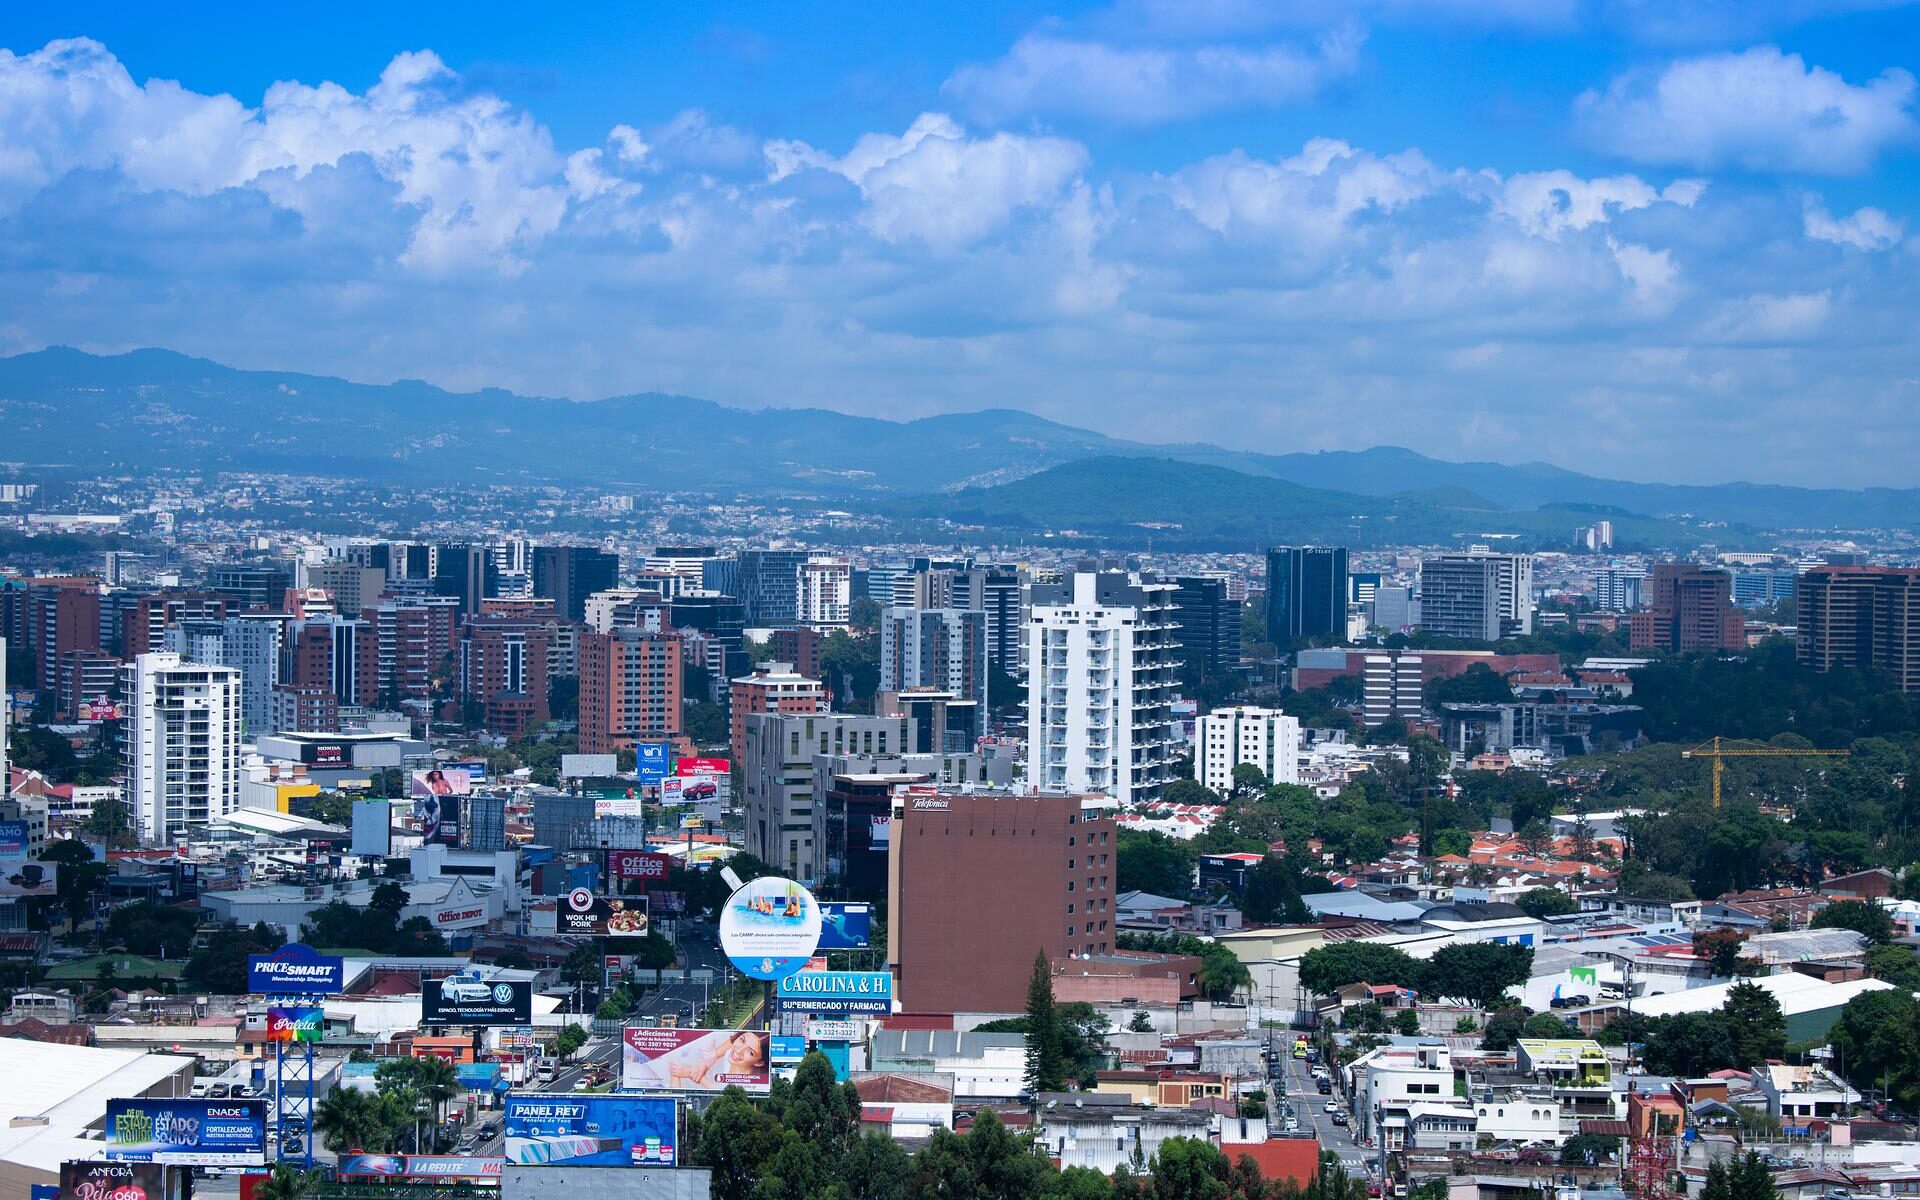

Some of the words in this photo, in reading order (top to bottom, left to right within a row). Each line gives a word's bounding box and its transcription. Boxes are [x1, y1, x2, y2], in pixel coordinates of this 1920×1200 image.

[621, 856, 664, 868] Office
[622, 867, 662, 876] DEPOT
[437, 911, 461, 922] Office
[461, 908, 483, 920] DEPOT
[570, 920, 592, 928] PORK
[782, 975, 856, 993] CAROLINA
[858, 977, 870, 993] &
[873, 977, 887, 993] H.
[843, 1002, 849, 1010] Y
[849, 1002, 886, 1011] FARMACIA
[273, 1019, 317, 1030] Paleta
[126, 1108, 135, 1118] DE
[163, 1110, 173, 1118] UN
[516, 1105, 553, 1116] PANEL
[555, 1106, 580, 1117] REY
[115, 1114, 153, 1130] ESTADO
[155, 1117, 199, 1132] ESTADO
[88, 1167, 134, 1177] ANFORA
[413, 1162, 428, 1173] LA
[428, 1162, 448, 1173] RED
[448, 1163, 464, 1173] LTE
